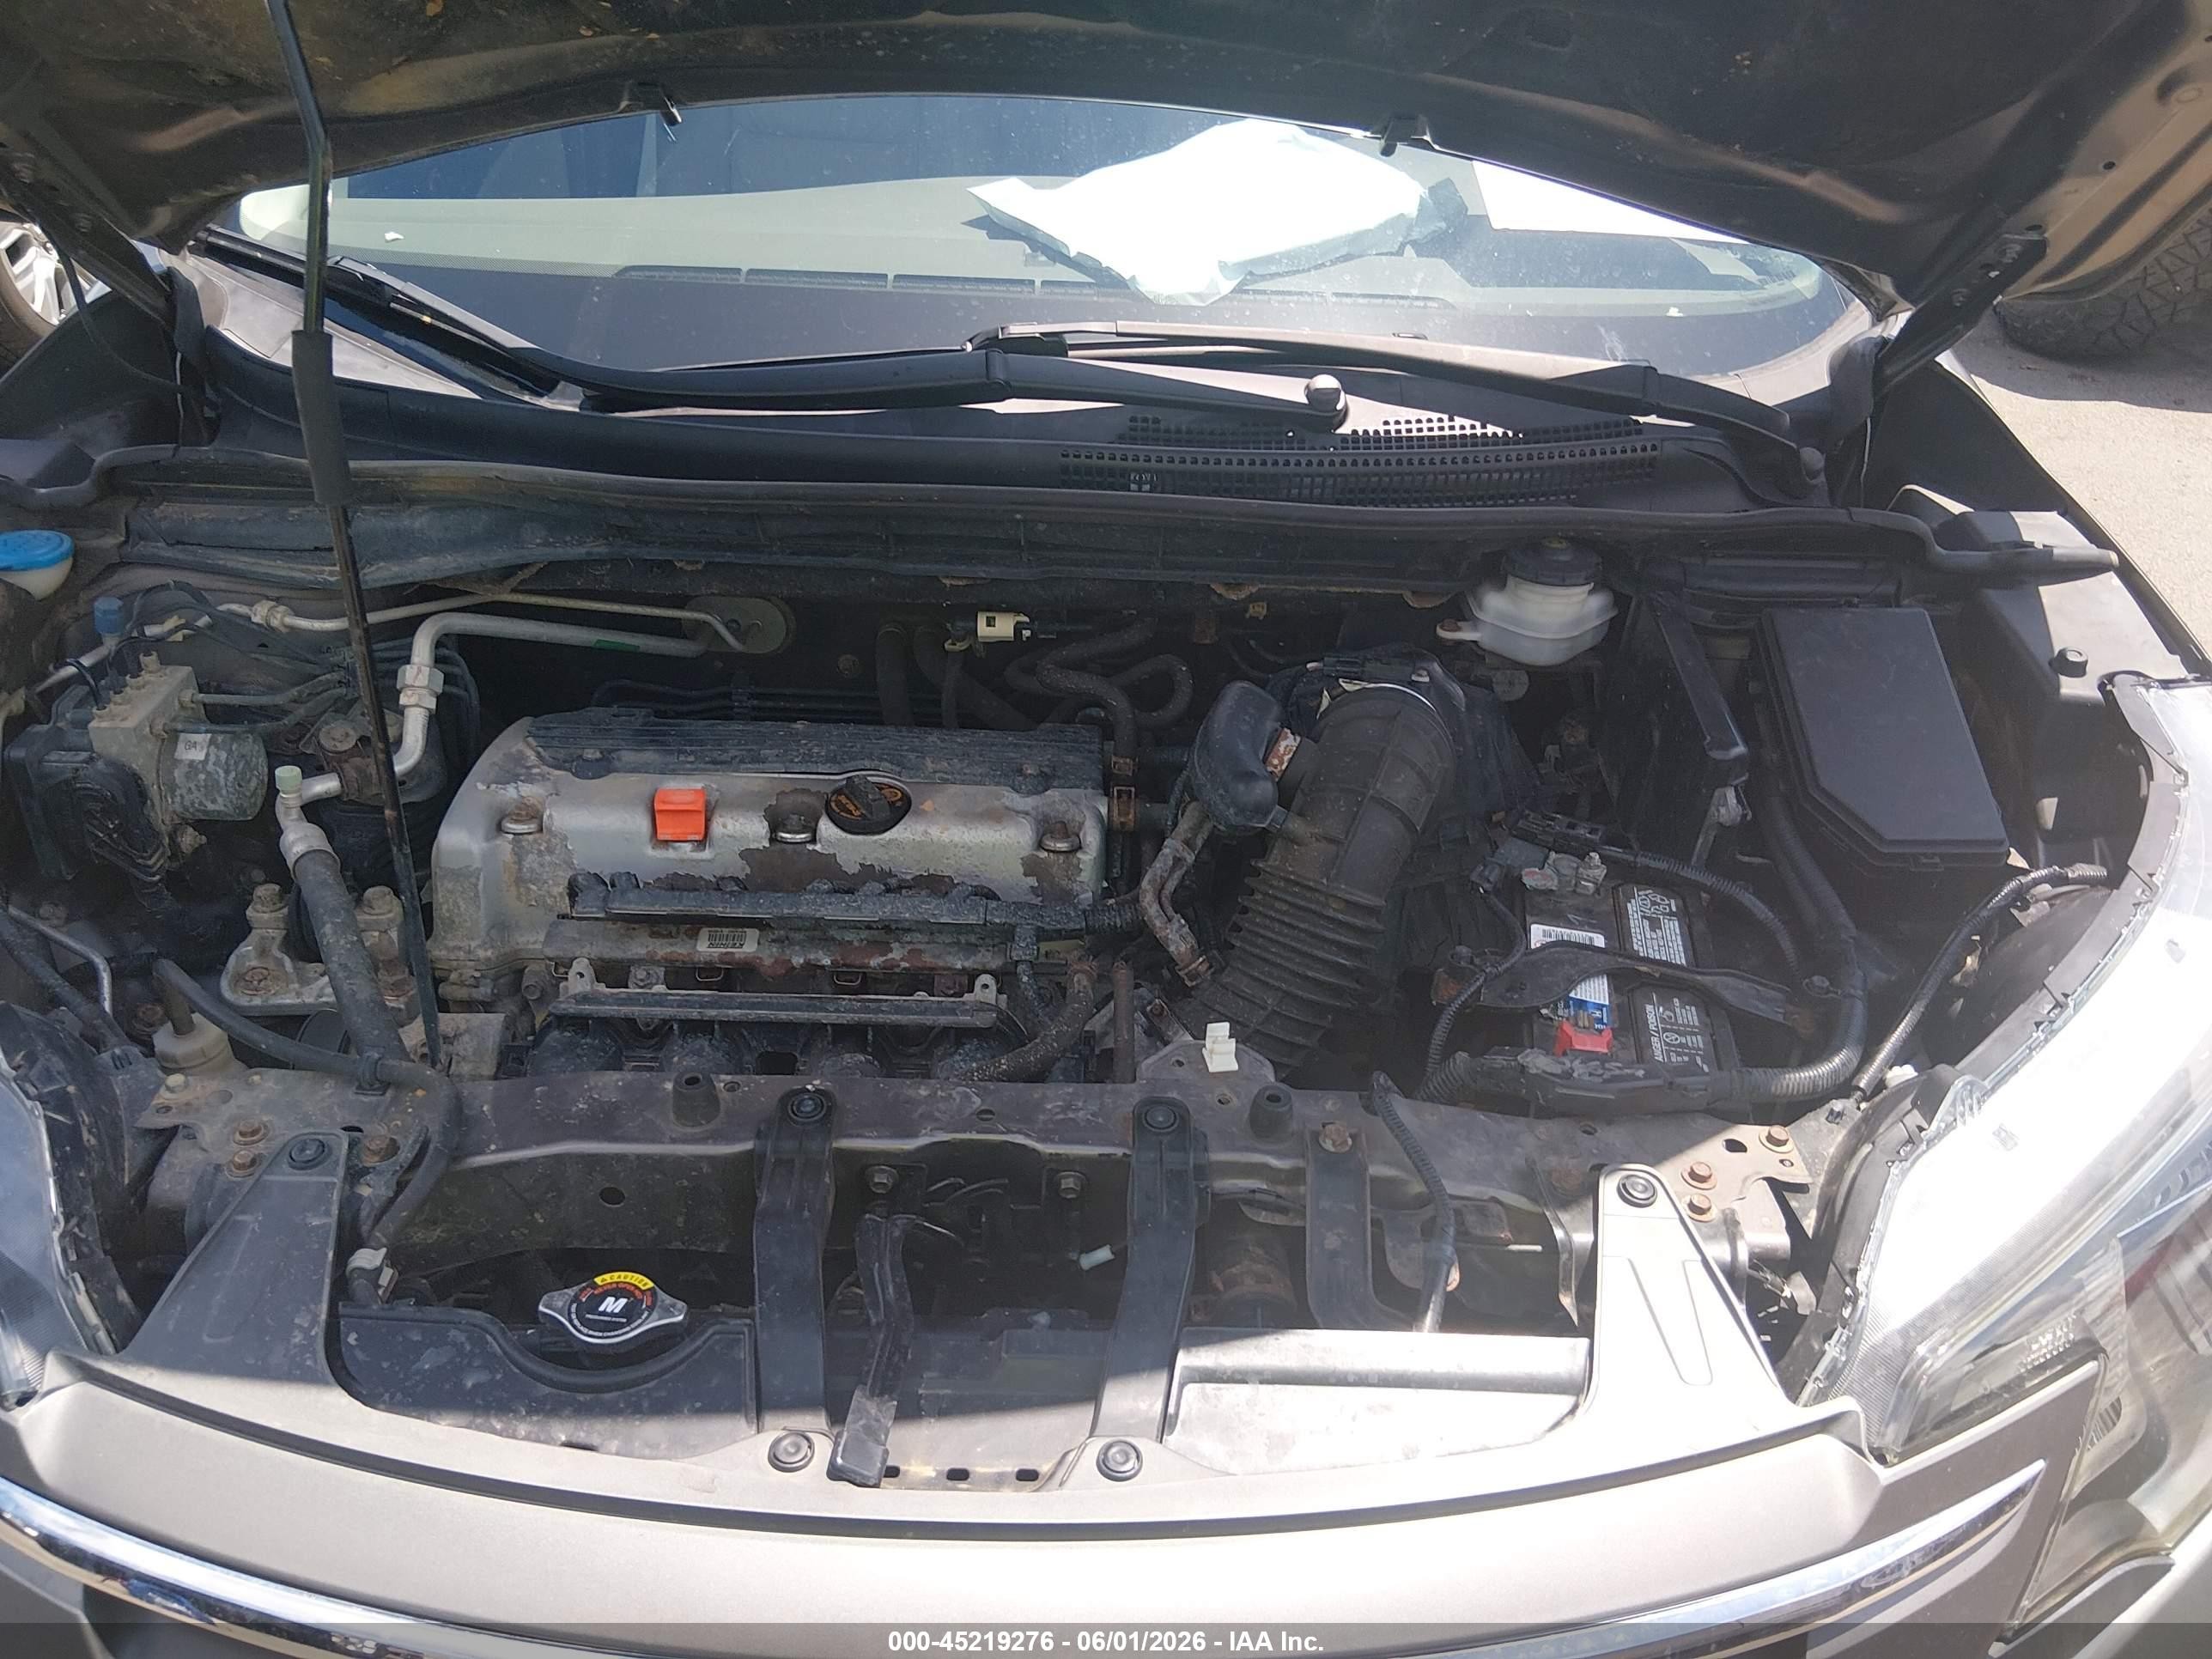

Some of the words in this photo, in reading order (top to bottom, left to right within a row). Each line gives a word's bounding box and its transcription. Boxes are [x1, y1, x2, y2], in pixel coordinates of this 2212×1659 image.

[1645, 1004, 1664, 1062] ANGER/POISON
[610, 1273, 649, 1288] CAUTION
[599, 1297, 628, 1313] M
